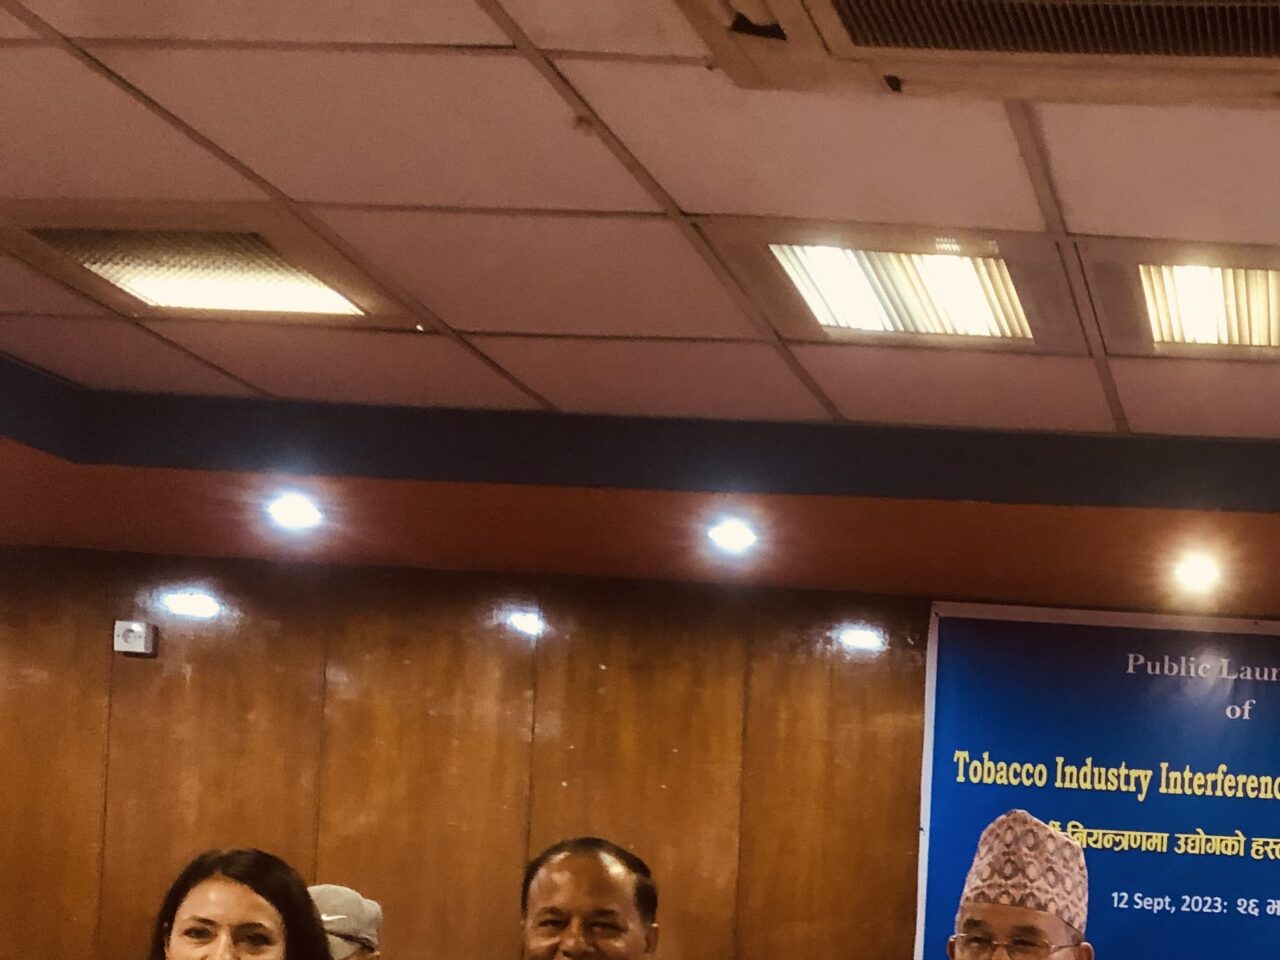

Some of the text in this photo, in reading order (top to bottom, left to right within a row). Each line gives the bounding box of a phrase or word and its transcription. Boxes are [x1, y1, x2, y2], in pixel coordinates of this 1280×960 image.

[1126, 653, 1210, 677] Public
[1225, 699, 1256, 720] of
[953, 750, 1048, 788] Tobacco
[1054, 756, 1153, 802] Industry
[1174, 828, 1246, 857] उद्योगको
[1111, 892, 1129, 909] 12
[1133, 893, 1176, 914] Sept,
[1181, 895, 1228, 914] 2023:
